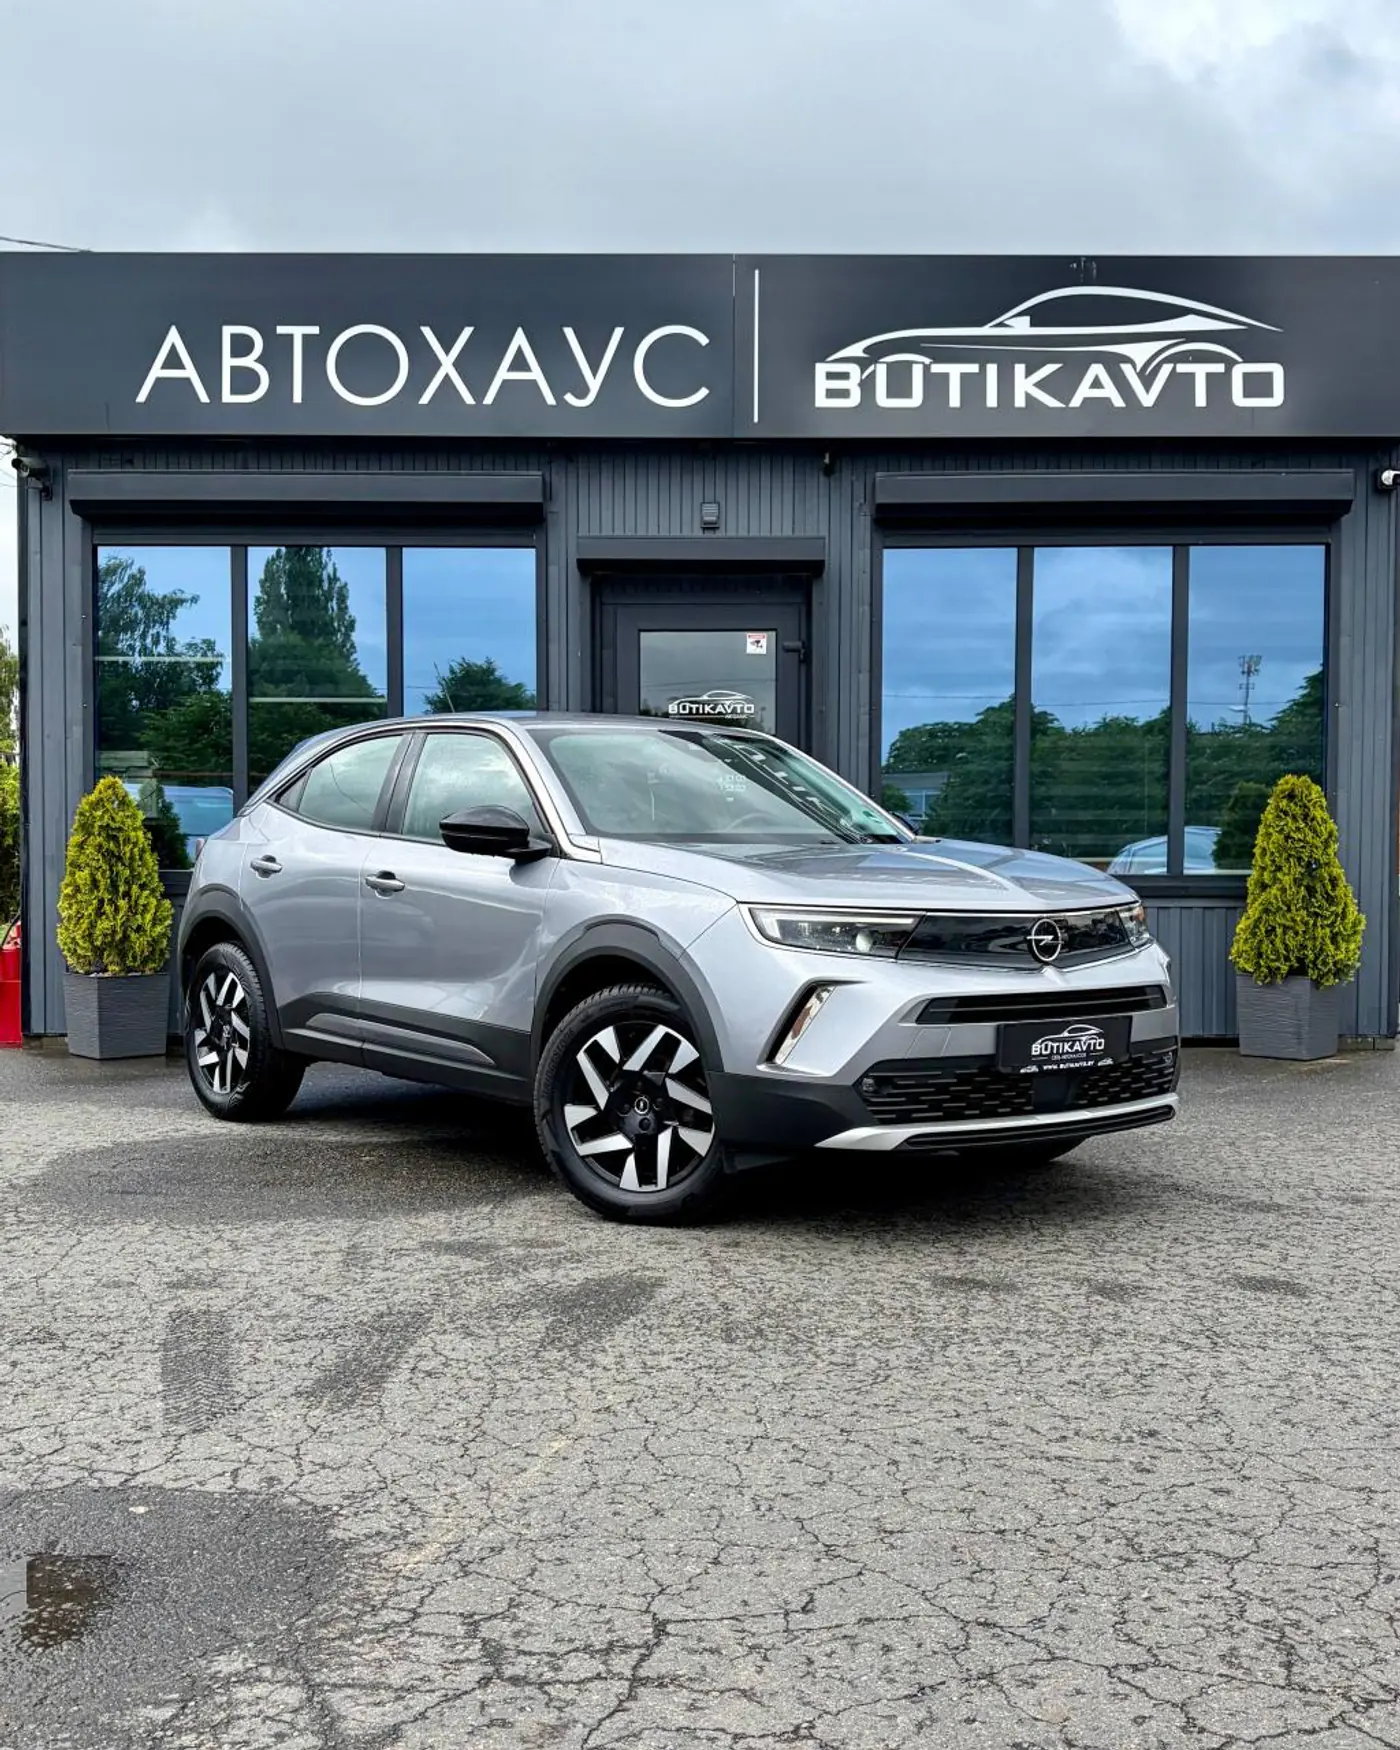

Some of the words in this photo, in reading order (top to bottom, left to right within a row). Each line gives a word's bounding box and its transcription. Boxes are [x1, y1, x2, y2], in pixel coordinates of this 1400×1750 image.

[135, 323, 710, 408] АВТОХАУС
[814, 361, 1286, 409] BUTIKAVTO
[668, 703, 755, 714] BUTIKAVTO
[1031, 1038, 1105, 1055] BUTIKAVTO
